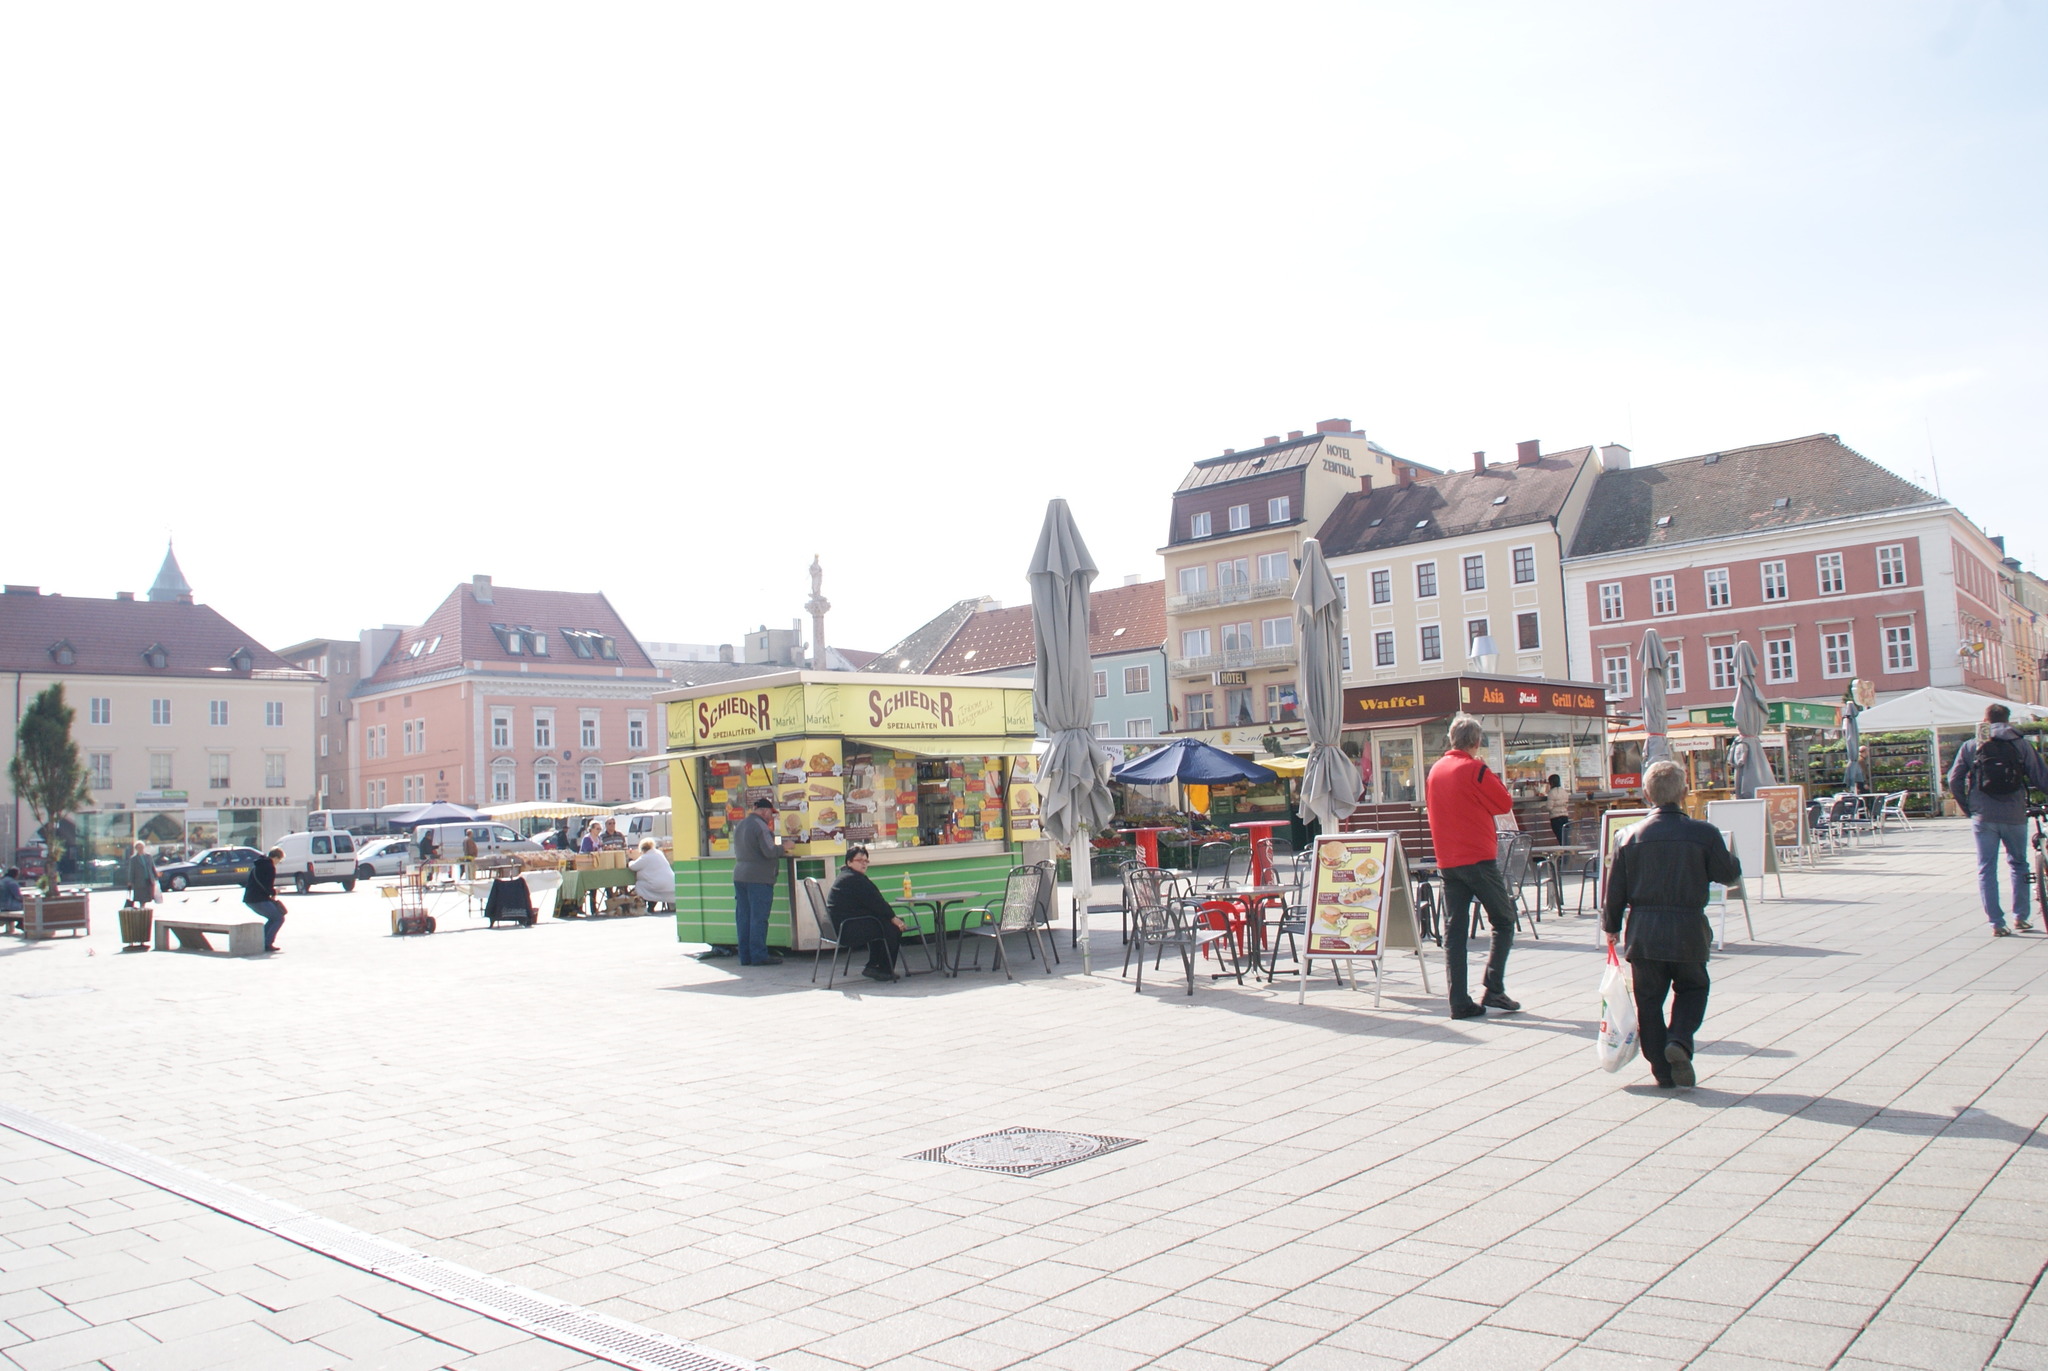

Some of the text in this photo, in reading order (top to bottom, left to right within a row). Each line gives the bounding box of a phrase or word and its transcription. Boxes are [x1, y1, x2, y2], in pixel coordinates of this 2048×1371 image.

[1326, 443, 1352, 461] HOTEL
[1322, 458, 1356, 479] ZENTRAL
[1221, 672, 1245, 684] HOTEL
[1360, 695, 1425, 710] Waffel
[1483, 687, 1504, 703] Asia
[1519, 691, 1538, 704] Markt
[1552, 693, 1572, 708] Grill
[1577, 694, 1595, 708] Cafe
[868, 689, 954, 728] SCHIEDER
[698, 693, 771, 739] SCHIEDER
[775, 716, 796, 727] Markt
[806, 714, 830, 725] Markt
[1006, 716, 1026, 726] Markt
[887, 721, 938, 730] SPEZIALITÄTEN
[668, 730, 686, 740] Markt
[713, 727, 756, 739] SPEZIALITÄTEN
[224, 797, 290, 806] APOTHEKE
